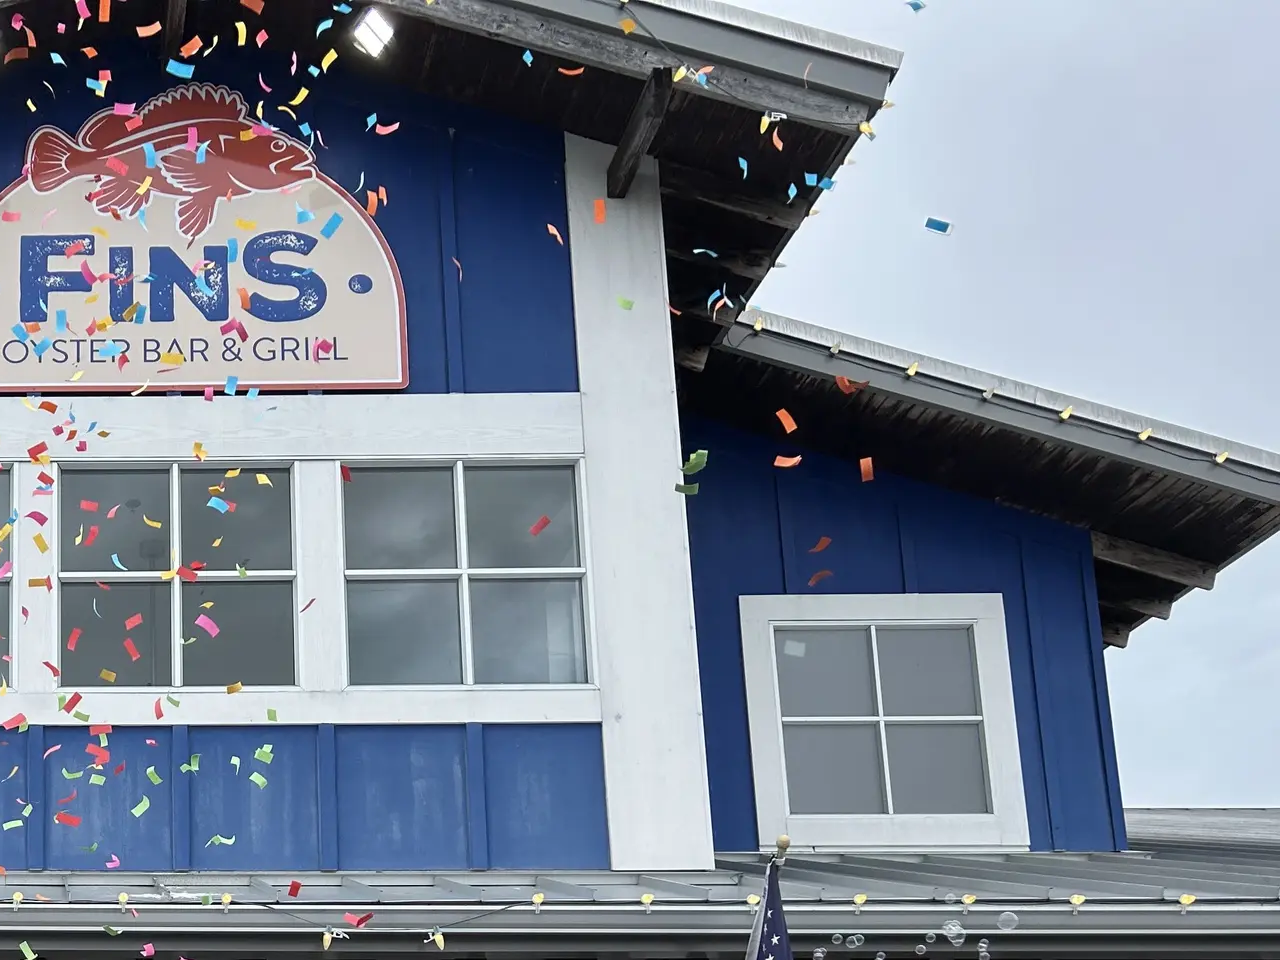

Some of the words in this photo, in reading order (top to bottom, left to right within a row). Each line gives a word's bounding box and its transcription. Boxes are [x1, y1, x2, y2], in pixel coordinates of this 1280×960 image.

[19, 230, 327, 323] FINS
[143, 338, 209, 363] BAR
[221, 337, 242, 362] &
[252, 336, 348, 361] GRILL
